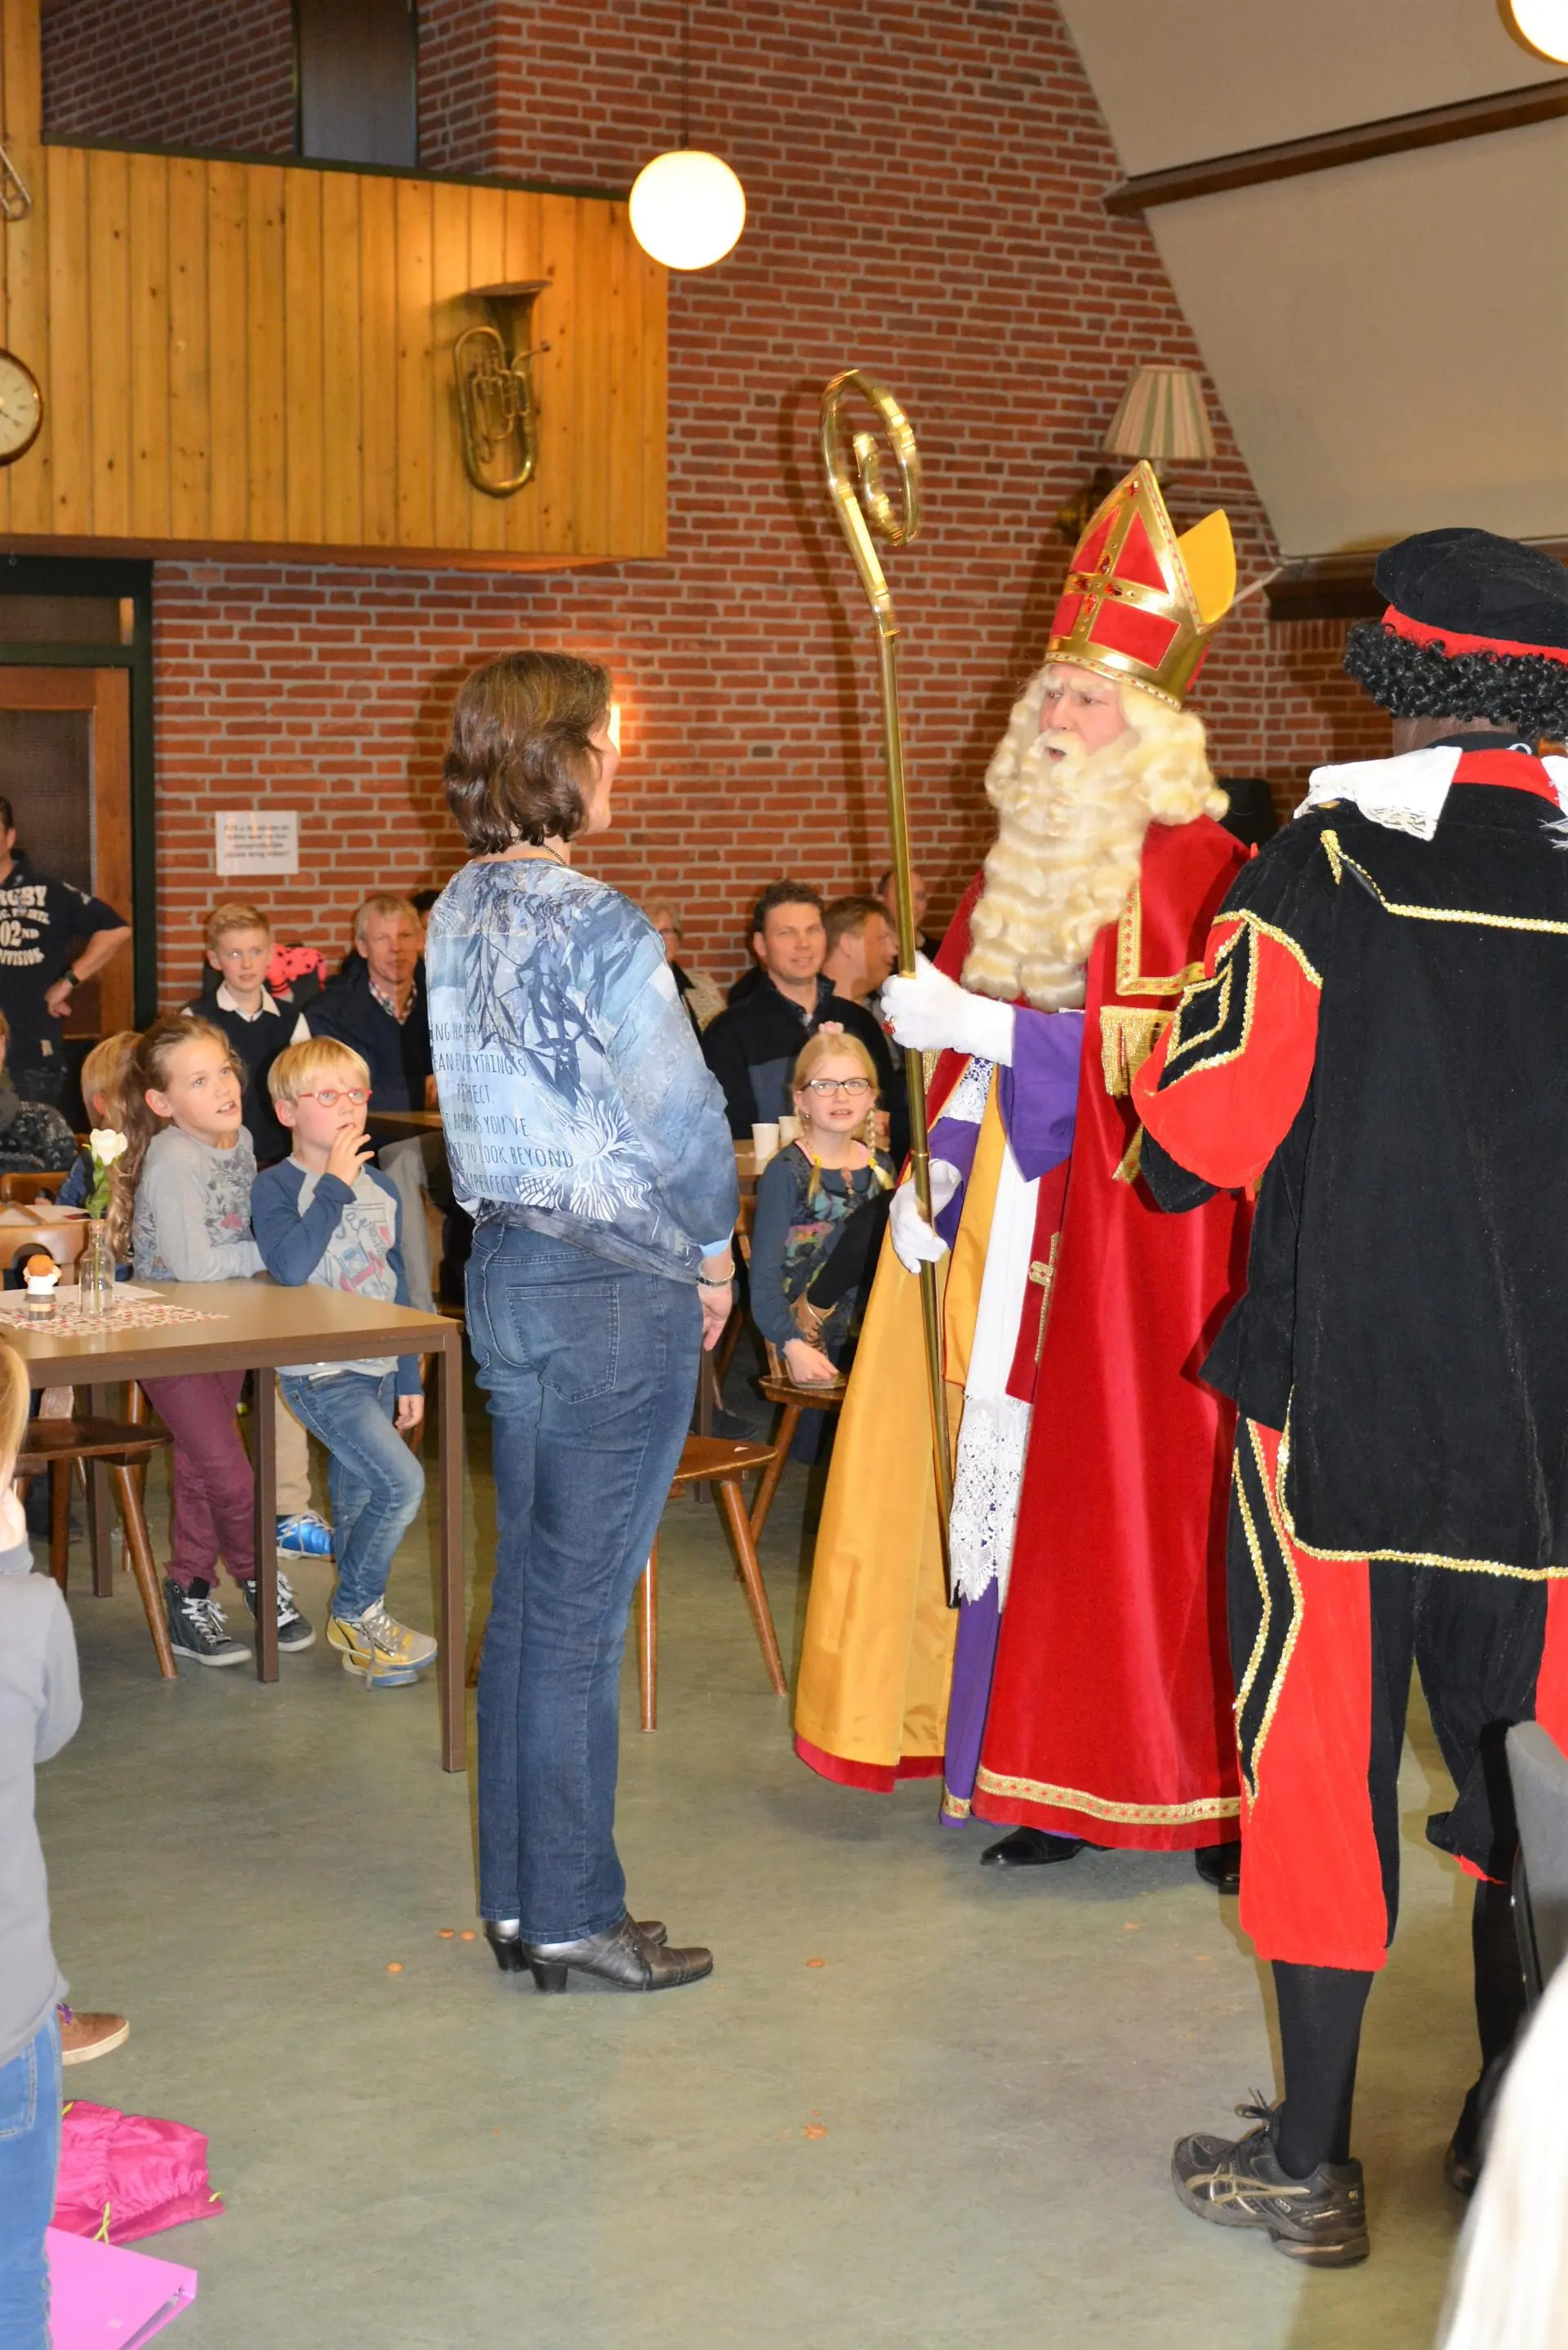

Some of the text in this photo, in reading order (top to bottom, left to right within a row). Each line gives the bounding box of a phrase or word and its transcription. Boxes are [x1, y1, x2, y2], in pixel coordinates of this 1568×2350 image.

[483, 1114, 530, 1137] YOU'VE
[466, 1143, 477, 1163] TO
[479, 1144, 508, 1164] LOOK
[510, 1145, 574, 1168] BEYOND
